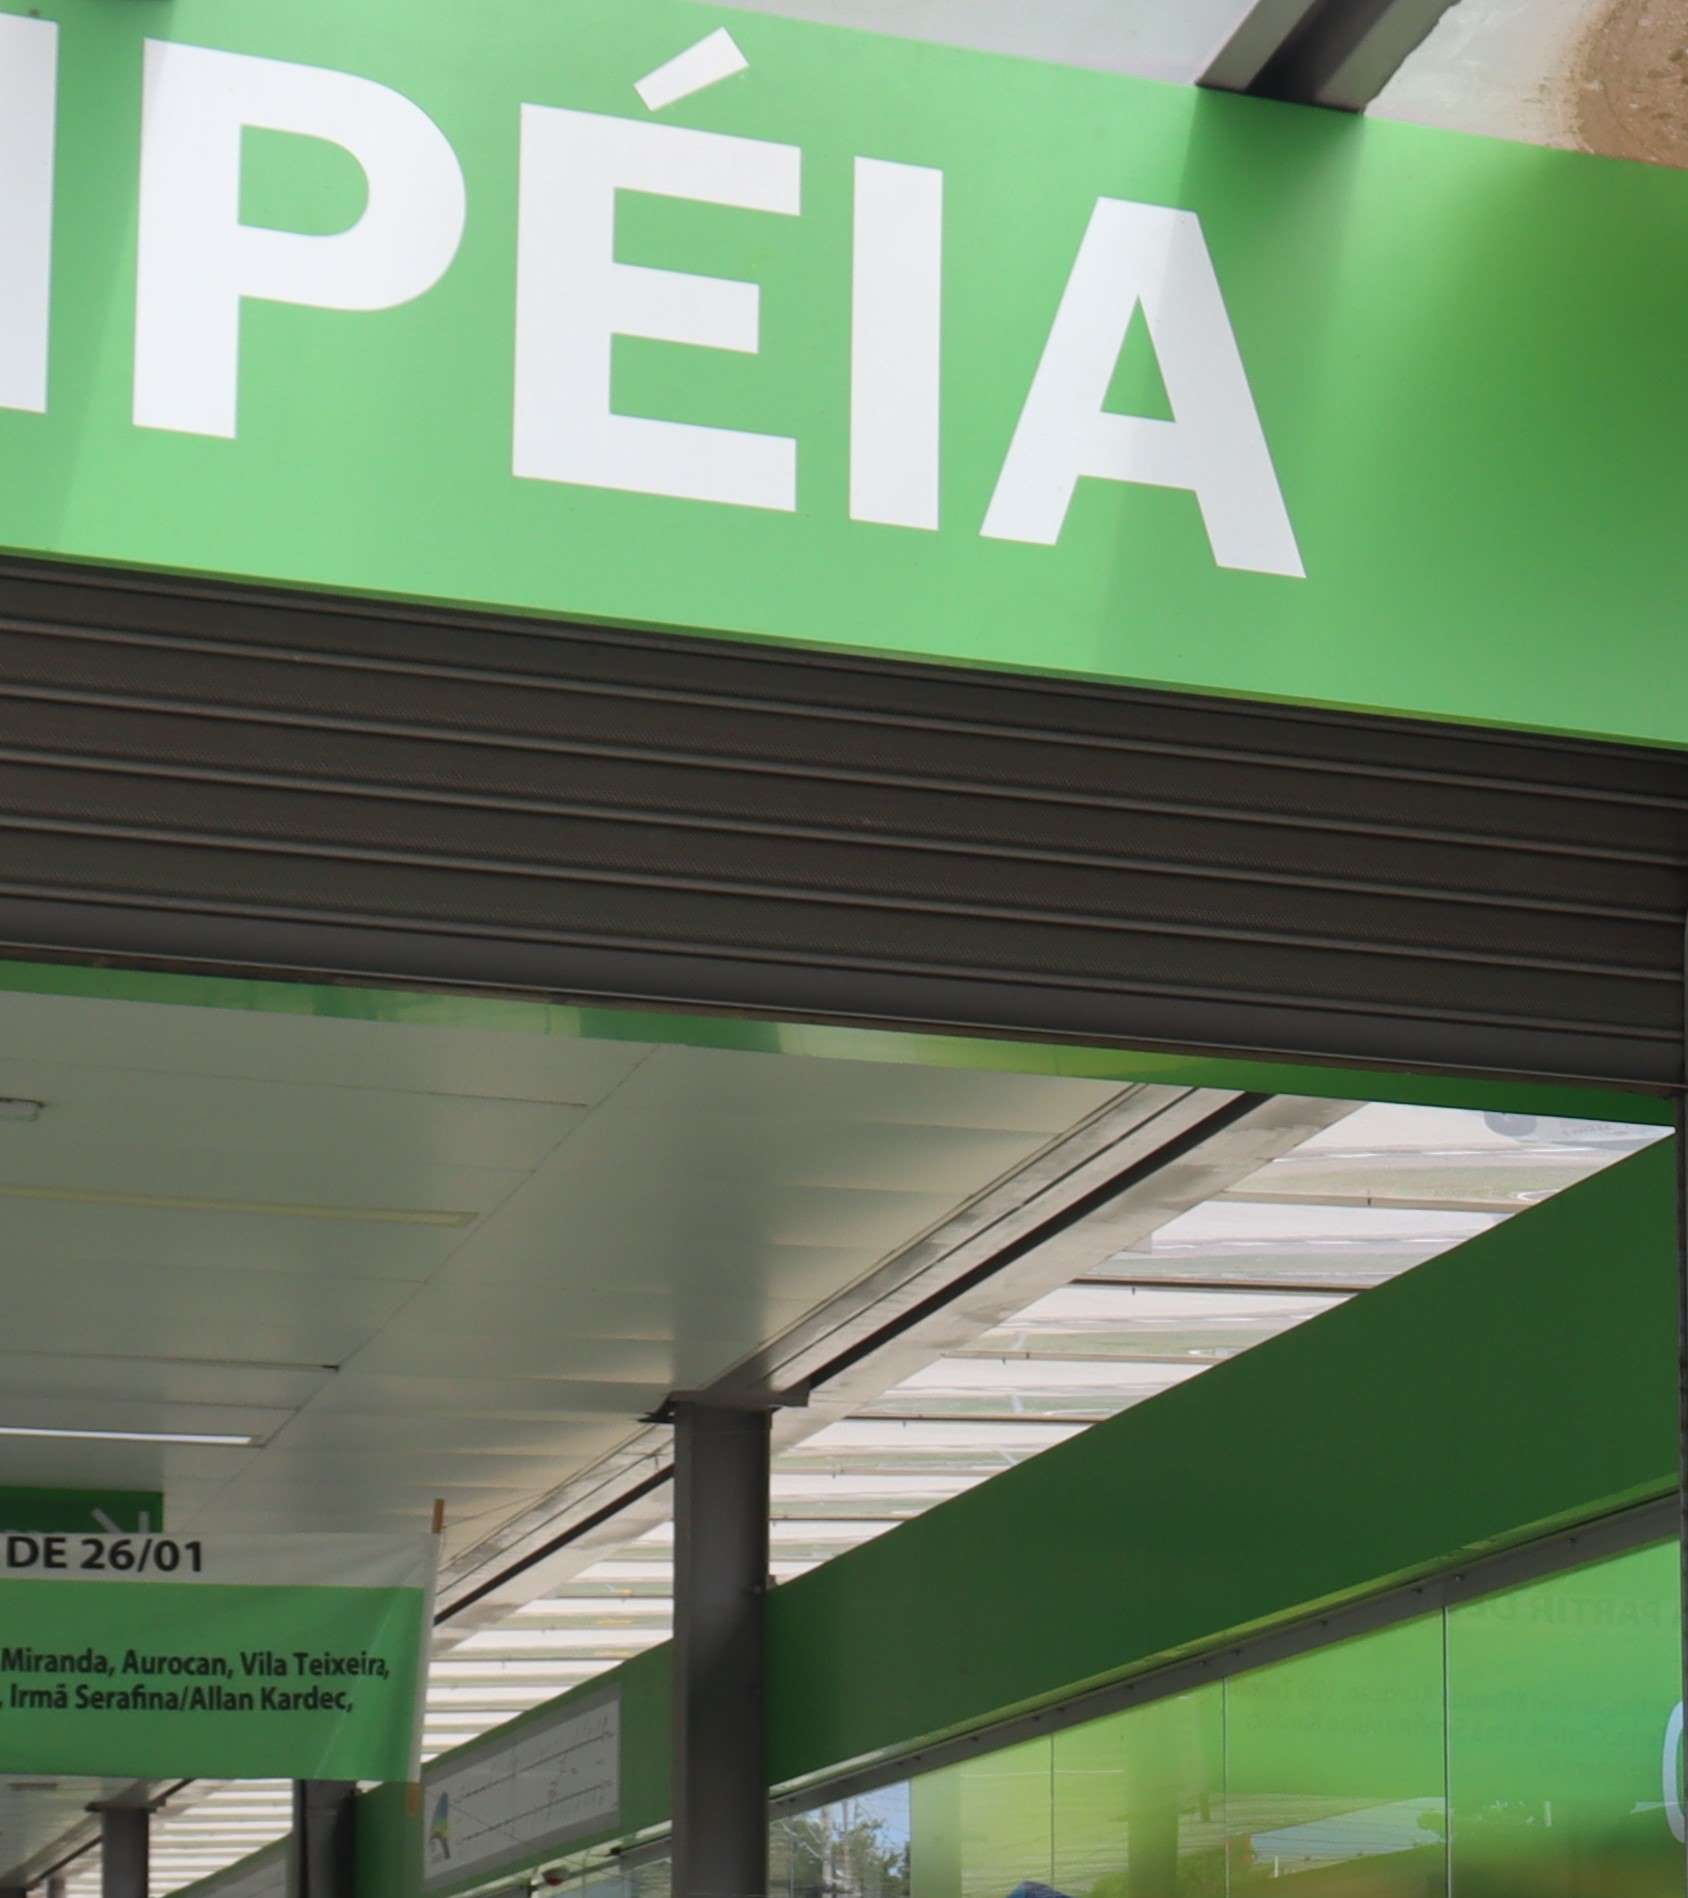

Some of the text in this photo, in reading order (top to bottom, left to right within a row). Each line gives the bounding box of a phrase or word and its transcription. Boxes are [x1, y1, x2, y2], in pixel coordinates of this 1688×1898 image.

[0, 14, 1307, 579] PÉIA
[6, 1536, 202, 1573] DE 26/01
[1, 1647, 390, 1679] Miranda, Aurocan, Vila Teixeira,
[10, 1683, 353, 1713] Irmã Serafina/Allan Kardec,
